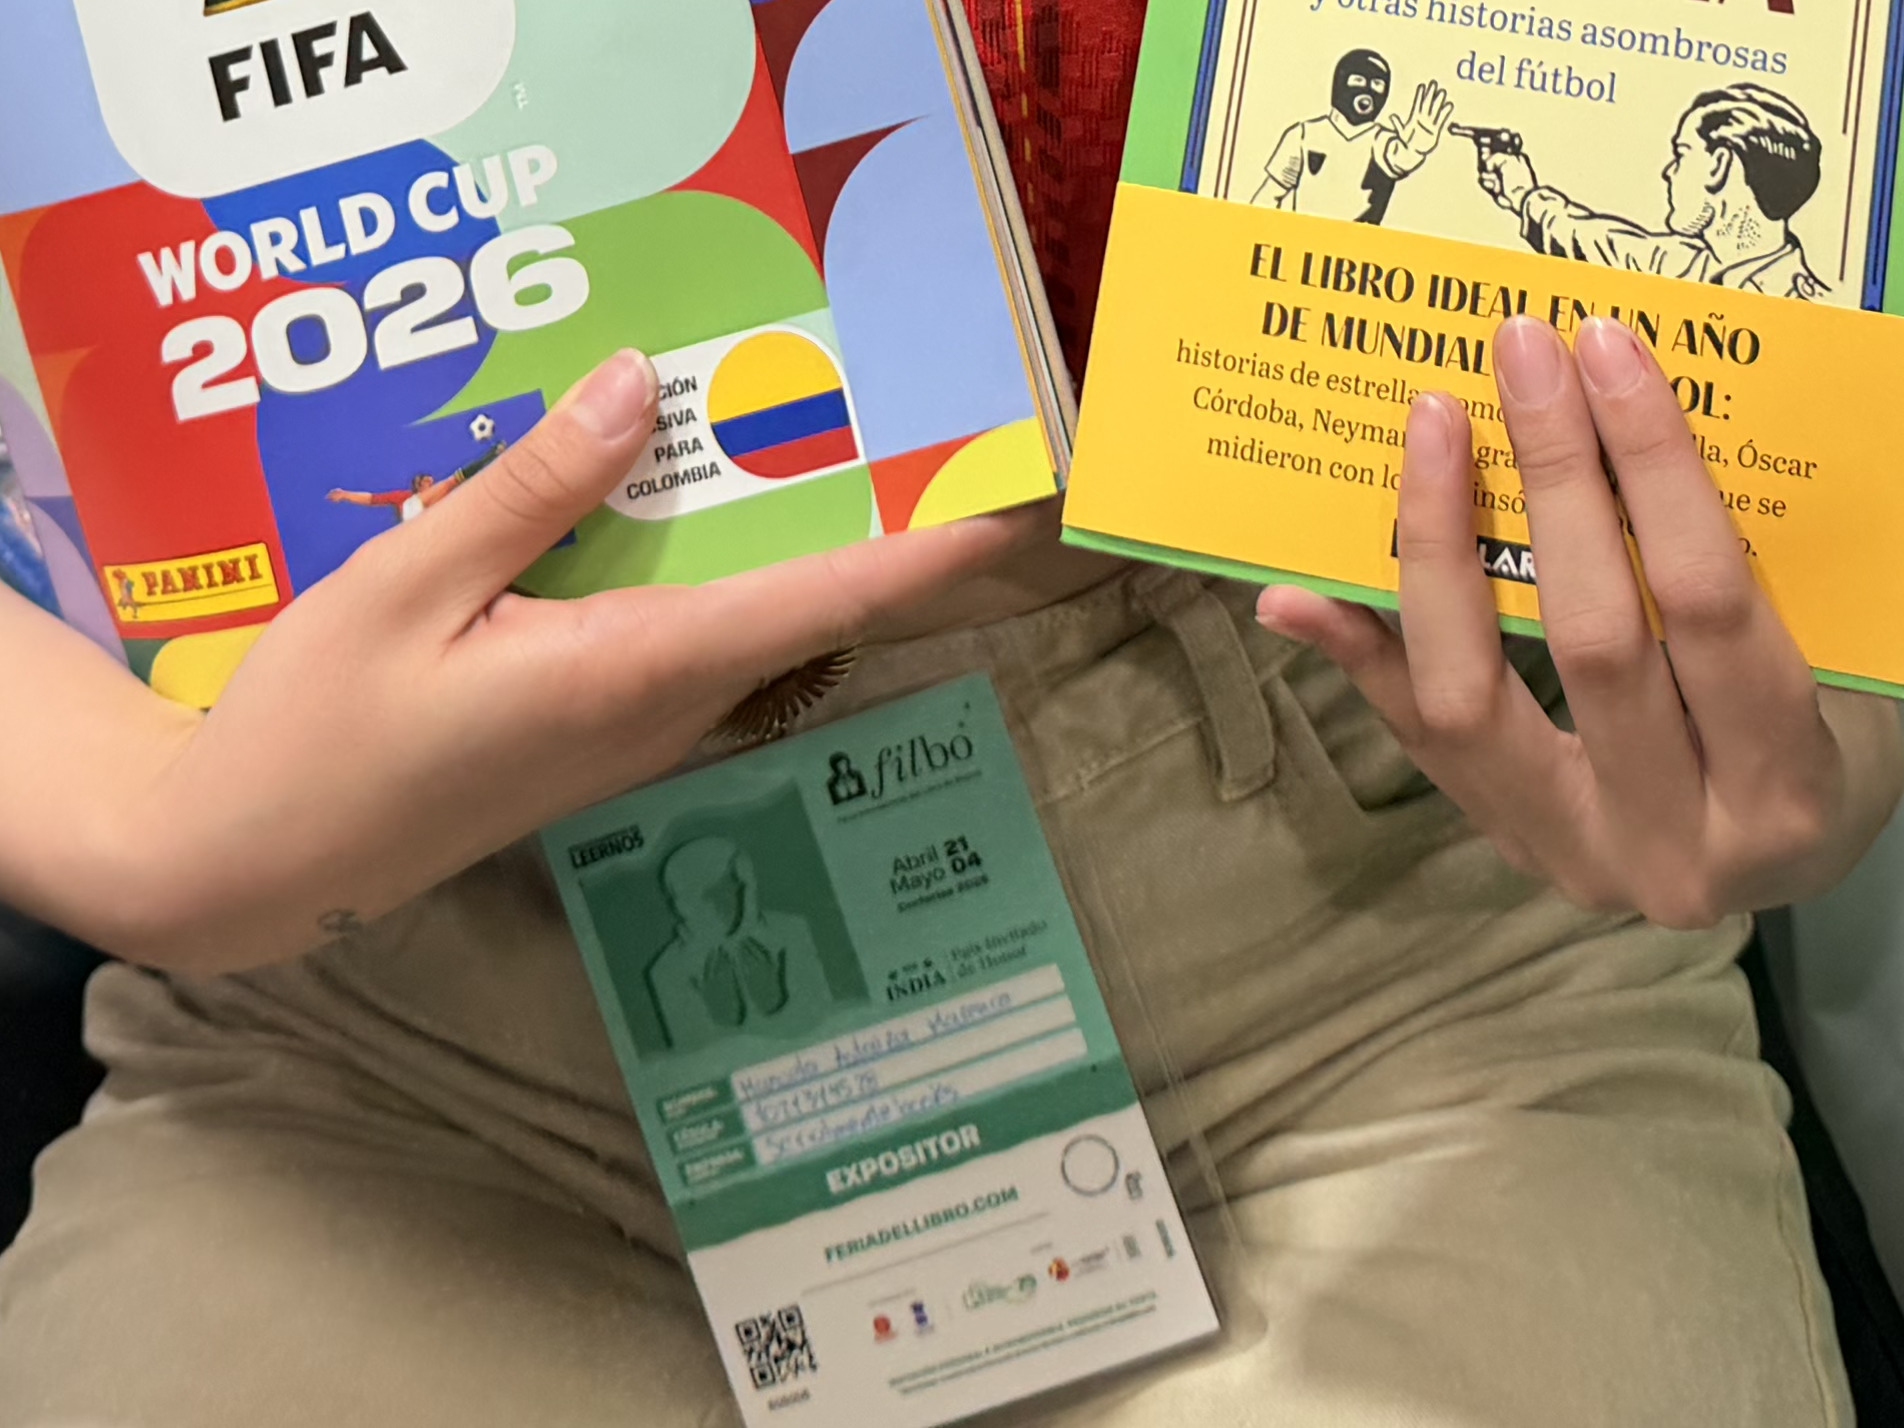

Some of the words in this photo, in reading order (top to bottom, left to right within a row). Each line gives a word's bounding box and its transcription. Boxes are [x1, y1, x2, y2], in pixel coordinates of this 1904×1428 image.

[208, 10, 409, 123] FIFA
[1456, 50, 1506, 86] del
[1514, 55, 1618, 104] fútbol
[1580, 20, 1789, 76] asombrosas
[137, 191, 396, 309] WORLD
[407, 144, 559, 233] CUP
[160, 224, 590, 424] 2026
[1249, 242, 1287, 283] EL
[1301, 251, 1416, 304] LIBRO
[1427, 273, 1529, 320] IDEAL
[1671, 312, 1761, 366] AÑO
[1176, 338, 1285, 381] historias
[1290, 361, 1320, 388] de
[1262, 301, 1312, 344] DE
[1321, 311, 1491, 378] MUNDIAL
[654, 436, 704, 466] PARA
[1192, 385, 1304, 432] Córdoba,
[1736, 439, 1819, 481] Óscar
[626, 460, 722, 501] COLOMBIA
[1206, 434, 1322, 476] midieron
[1329, 459, 1375, 487] con
[1473, 481, 1527, 516] insó
[1757, 493, 1787, 519] se
[141, 553, 264, 597] PANINI
[890, 865, 946, 895] Mayo
[950, 851, 982, 874] 04
[892, 844, 939, 875] Abril
[943, 835, 969, 856] 21
[885, 970, 946, 1001] INDIA
[825, 1123, 981, 1195] EXPOSITOR
[824, 1185, 1020, 1264] FERIADELLIBRO.COM
